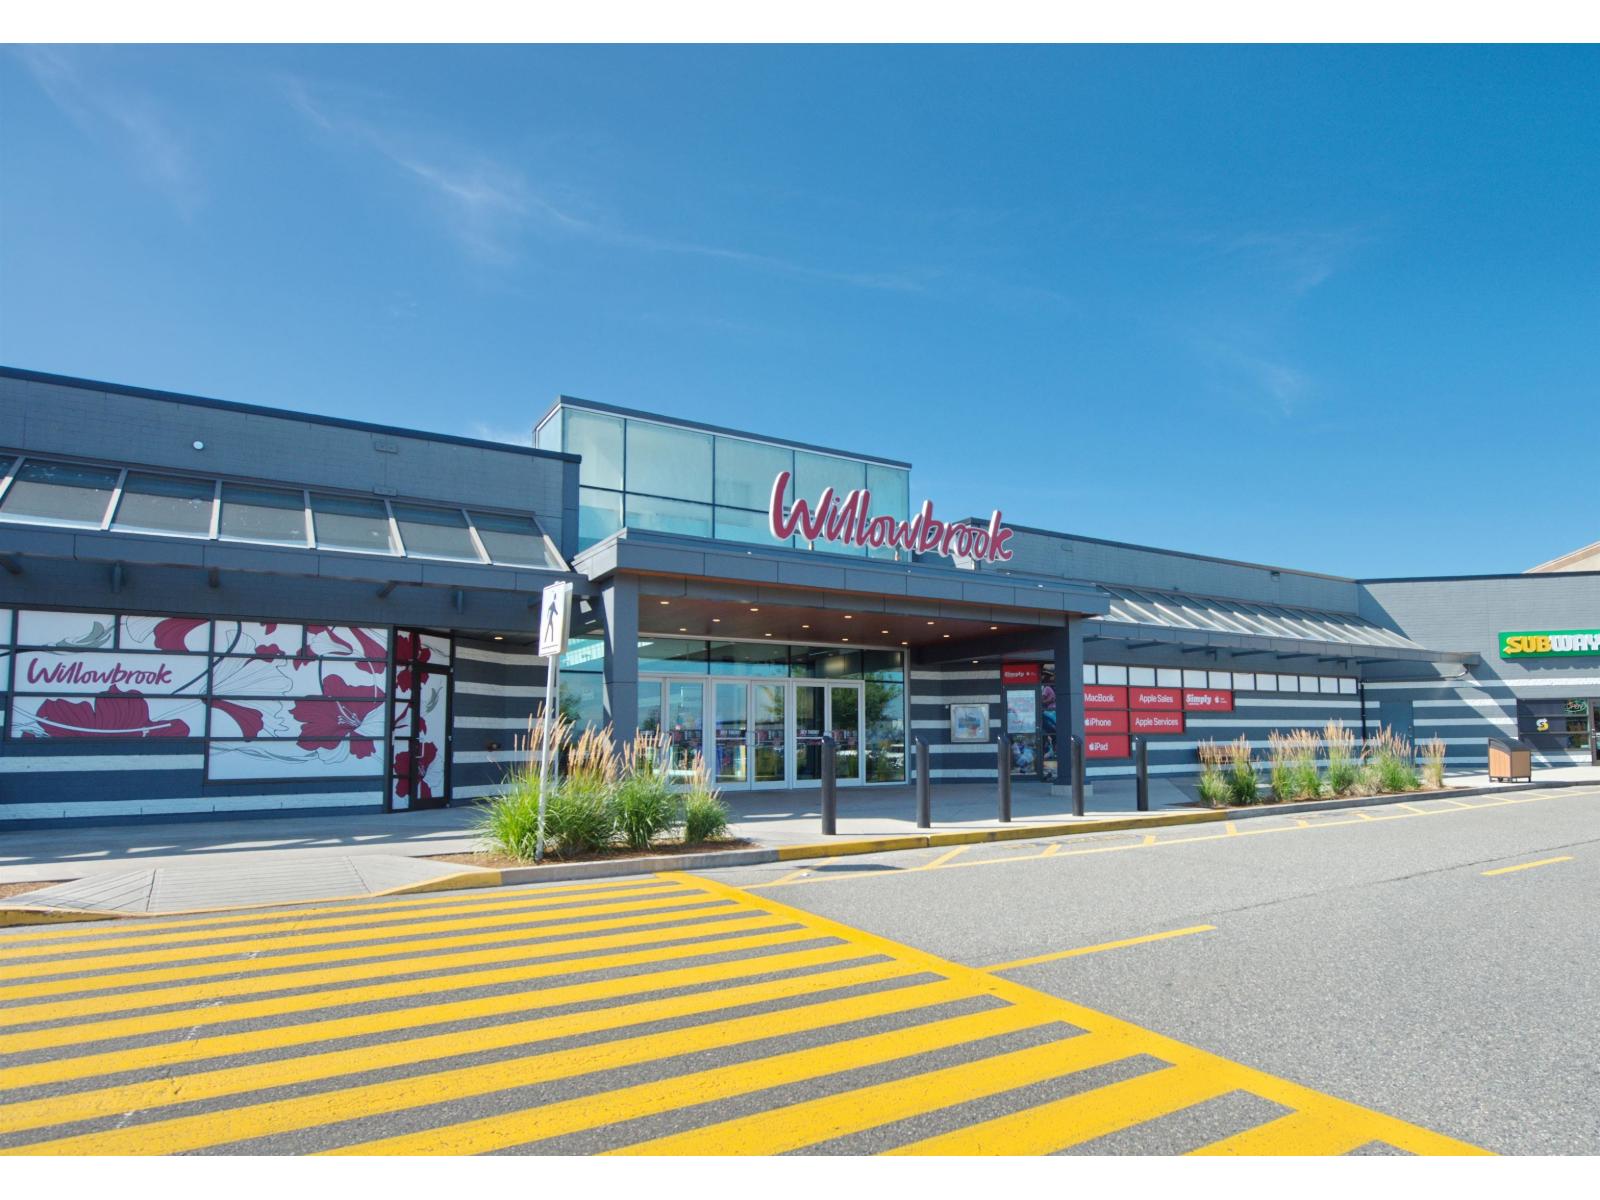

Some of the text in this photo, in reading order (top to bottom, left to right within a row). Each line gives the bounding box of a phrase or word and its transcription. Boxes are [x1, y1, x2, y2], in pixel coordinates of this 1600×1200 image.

[769, 471, 1014, 563] Willowbrook
[1503, 634, 1600, 654] SUBWAY
[27, 657, 172, 685] Willowbrook
[1084, 693, 1115, 702] MacBook
[1139, 694, 1173, 703] Apple Sales
[1186, 694, 1211, 704] Simply
[1089, 718, 1112, 727] iPhone
[1135, 717, 1178, 727] Apple Services
[1094, 742, 1108, 751] iPad
